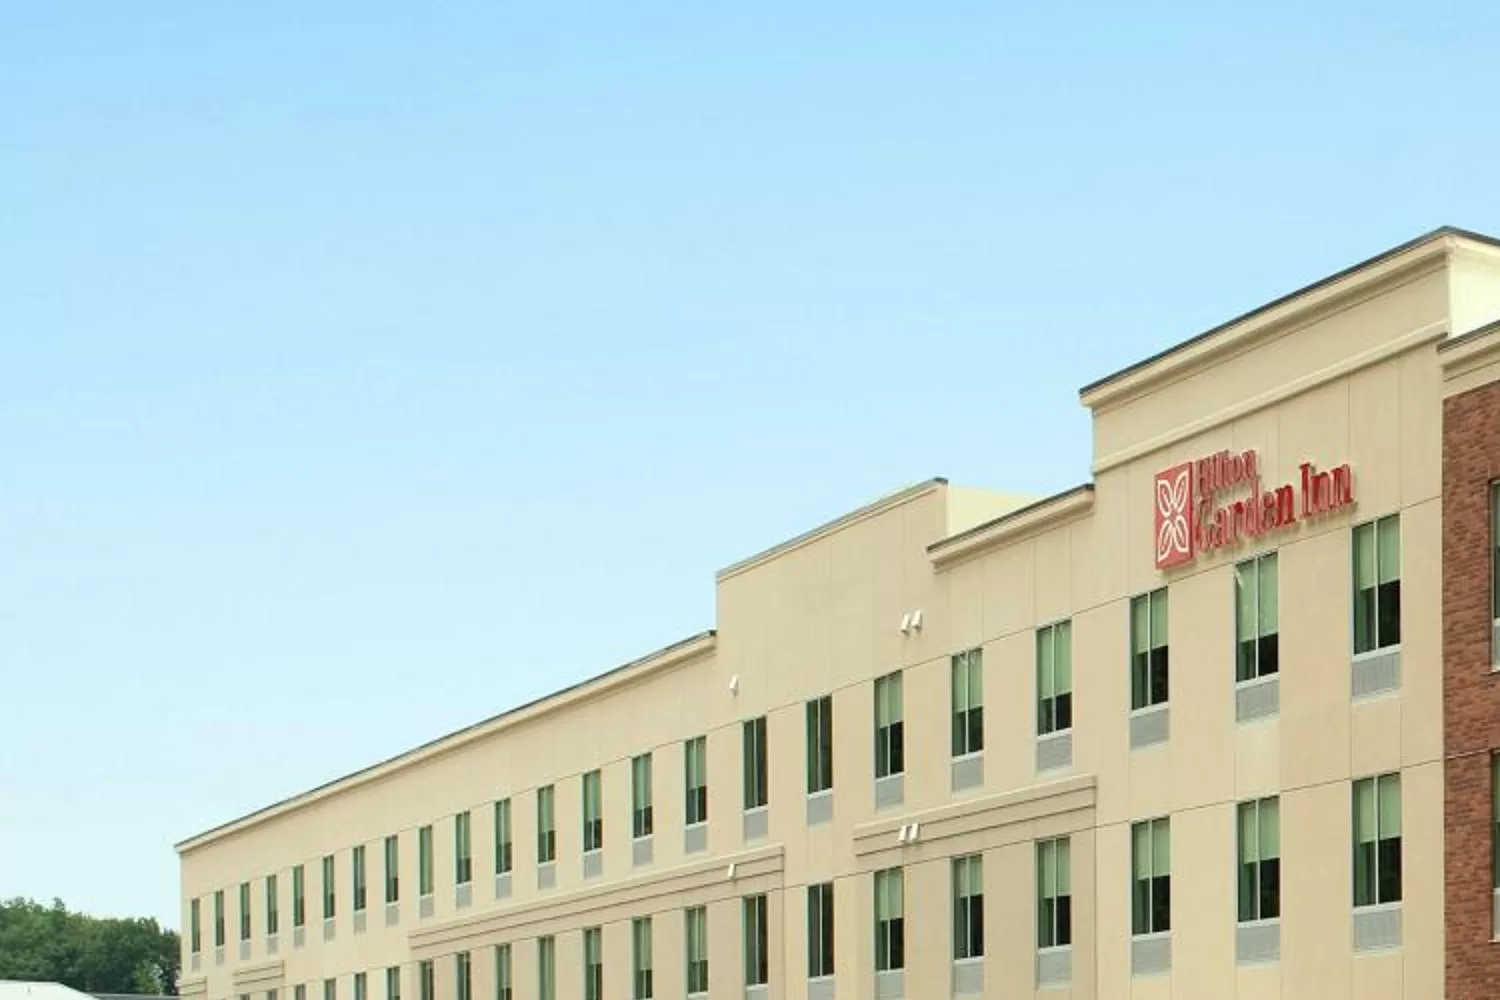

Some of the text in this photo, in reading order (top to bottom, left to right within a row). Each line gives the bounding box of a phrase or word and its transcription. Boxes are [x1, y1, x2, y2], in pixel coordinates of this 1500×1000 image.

[1193, 462, 1355, 552] Garden Inn
[1195, 449, 1258, 499] Hilton
